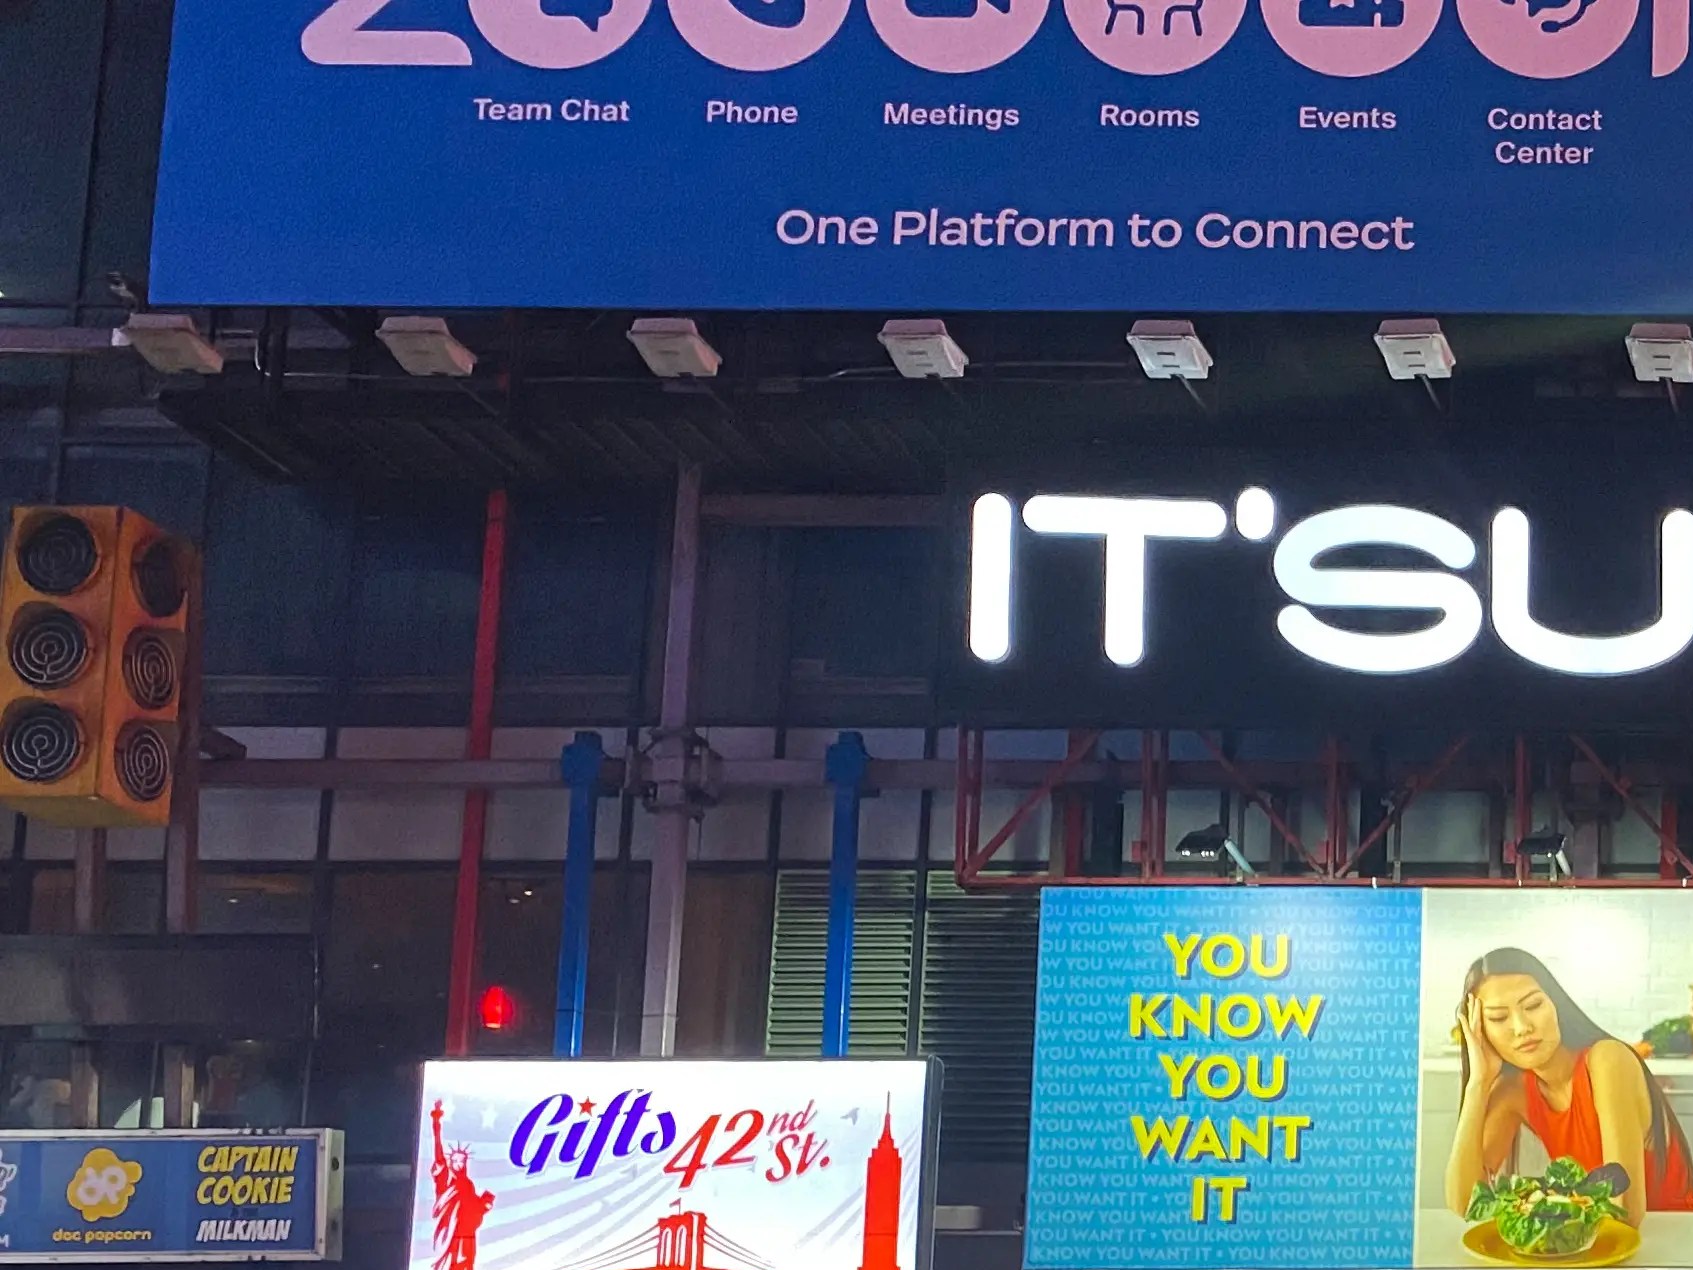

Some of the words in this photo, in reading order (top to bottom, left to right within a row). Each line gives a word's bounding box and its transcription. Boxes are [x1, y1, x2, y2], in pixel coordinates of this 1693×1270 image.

[473, 97, 552, 122] Team
[560, 98, 631, 123] Chat
[705, 100, 799, 125] Phone
[883, 102, 1020, 131] Meetings
[1100, 104, 1200, 128] Rooms
[1299, 106, 1397, 130] Events
[1487, 107, 1603, 132] Contact
[1494, 141, 1594, 165] Center
[776, 208, 879, 247] One
[893, 207, 1114, 248] Platform
[1127, 214, 1182, 249] to
[1195, 212, 1415, 252] Connect
[1163, 933, 1292, 980] YOU
[1127, 993, 1326, 1041] KNOW
[1158, 1055, 1289, 1102] YOU
[508, 1088, 677, 1180] Gifts
[1130, 1115, 1314, 1164] WANT
[197, 1145, 300, 1173] CAPTAIN
[196, 1174, 295, 1206] COOKIE
[1190, 1175, 1250, 1224] IT
[52, 1228, 81, 1242] doc
[85, 1230, 152, 1244] popcorn
[195, 1219, 292, 1243] MILKMAN
